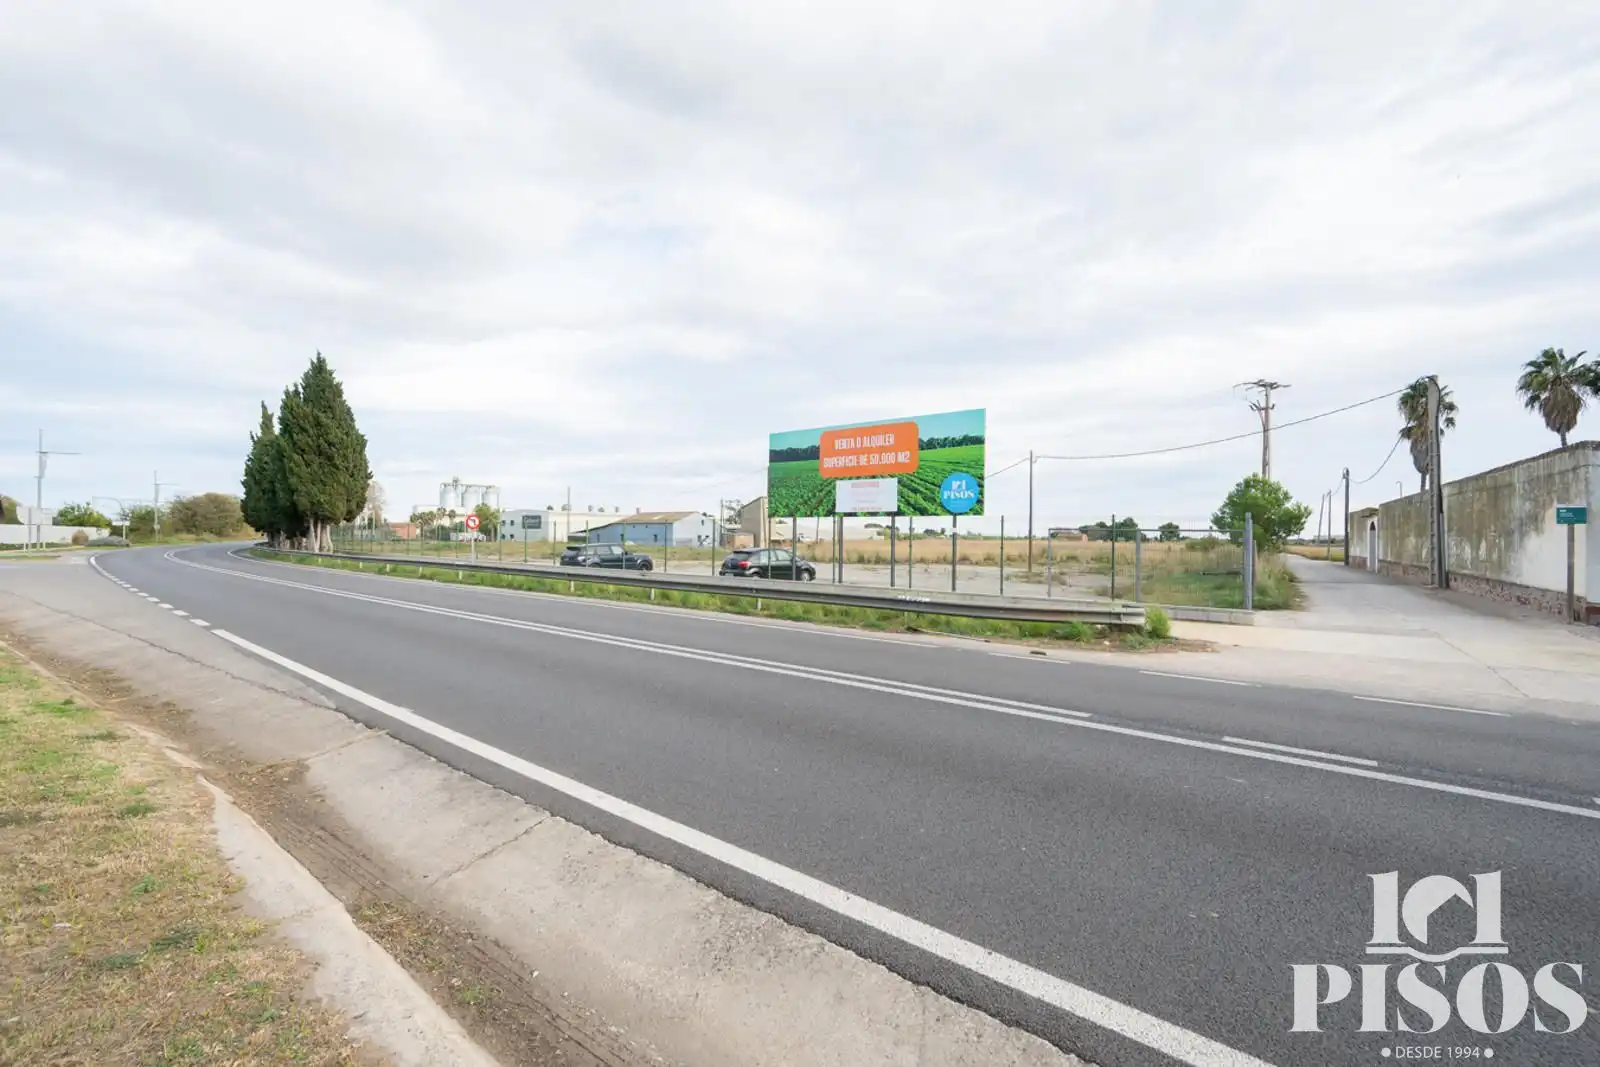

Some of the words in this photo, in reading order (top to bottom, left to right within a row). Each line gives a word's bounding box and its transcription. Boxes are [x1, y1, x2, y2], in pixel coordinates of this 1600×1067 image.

[834, 438, 855, 450] VENTA
[856, 436, 862, 448] O
[863, 433, 894, 447] ALQUILER
[823, 456, 857, 468] SUPERFICIE
[859, 454, 868, 466] DE
[869, 452, 896, 465] 50.000
[897, 451, 910, 463] M2
[943, 489, 975, 500] PISOS
